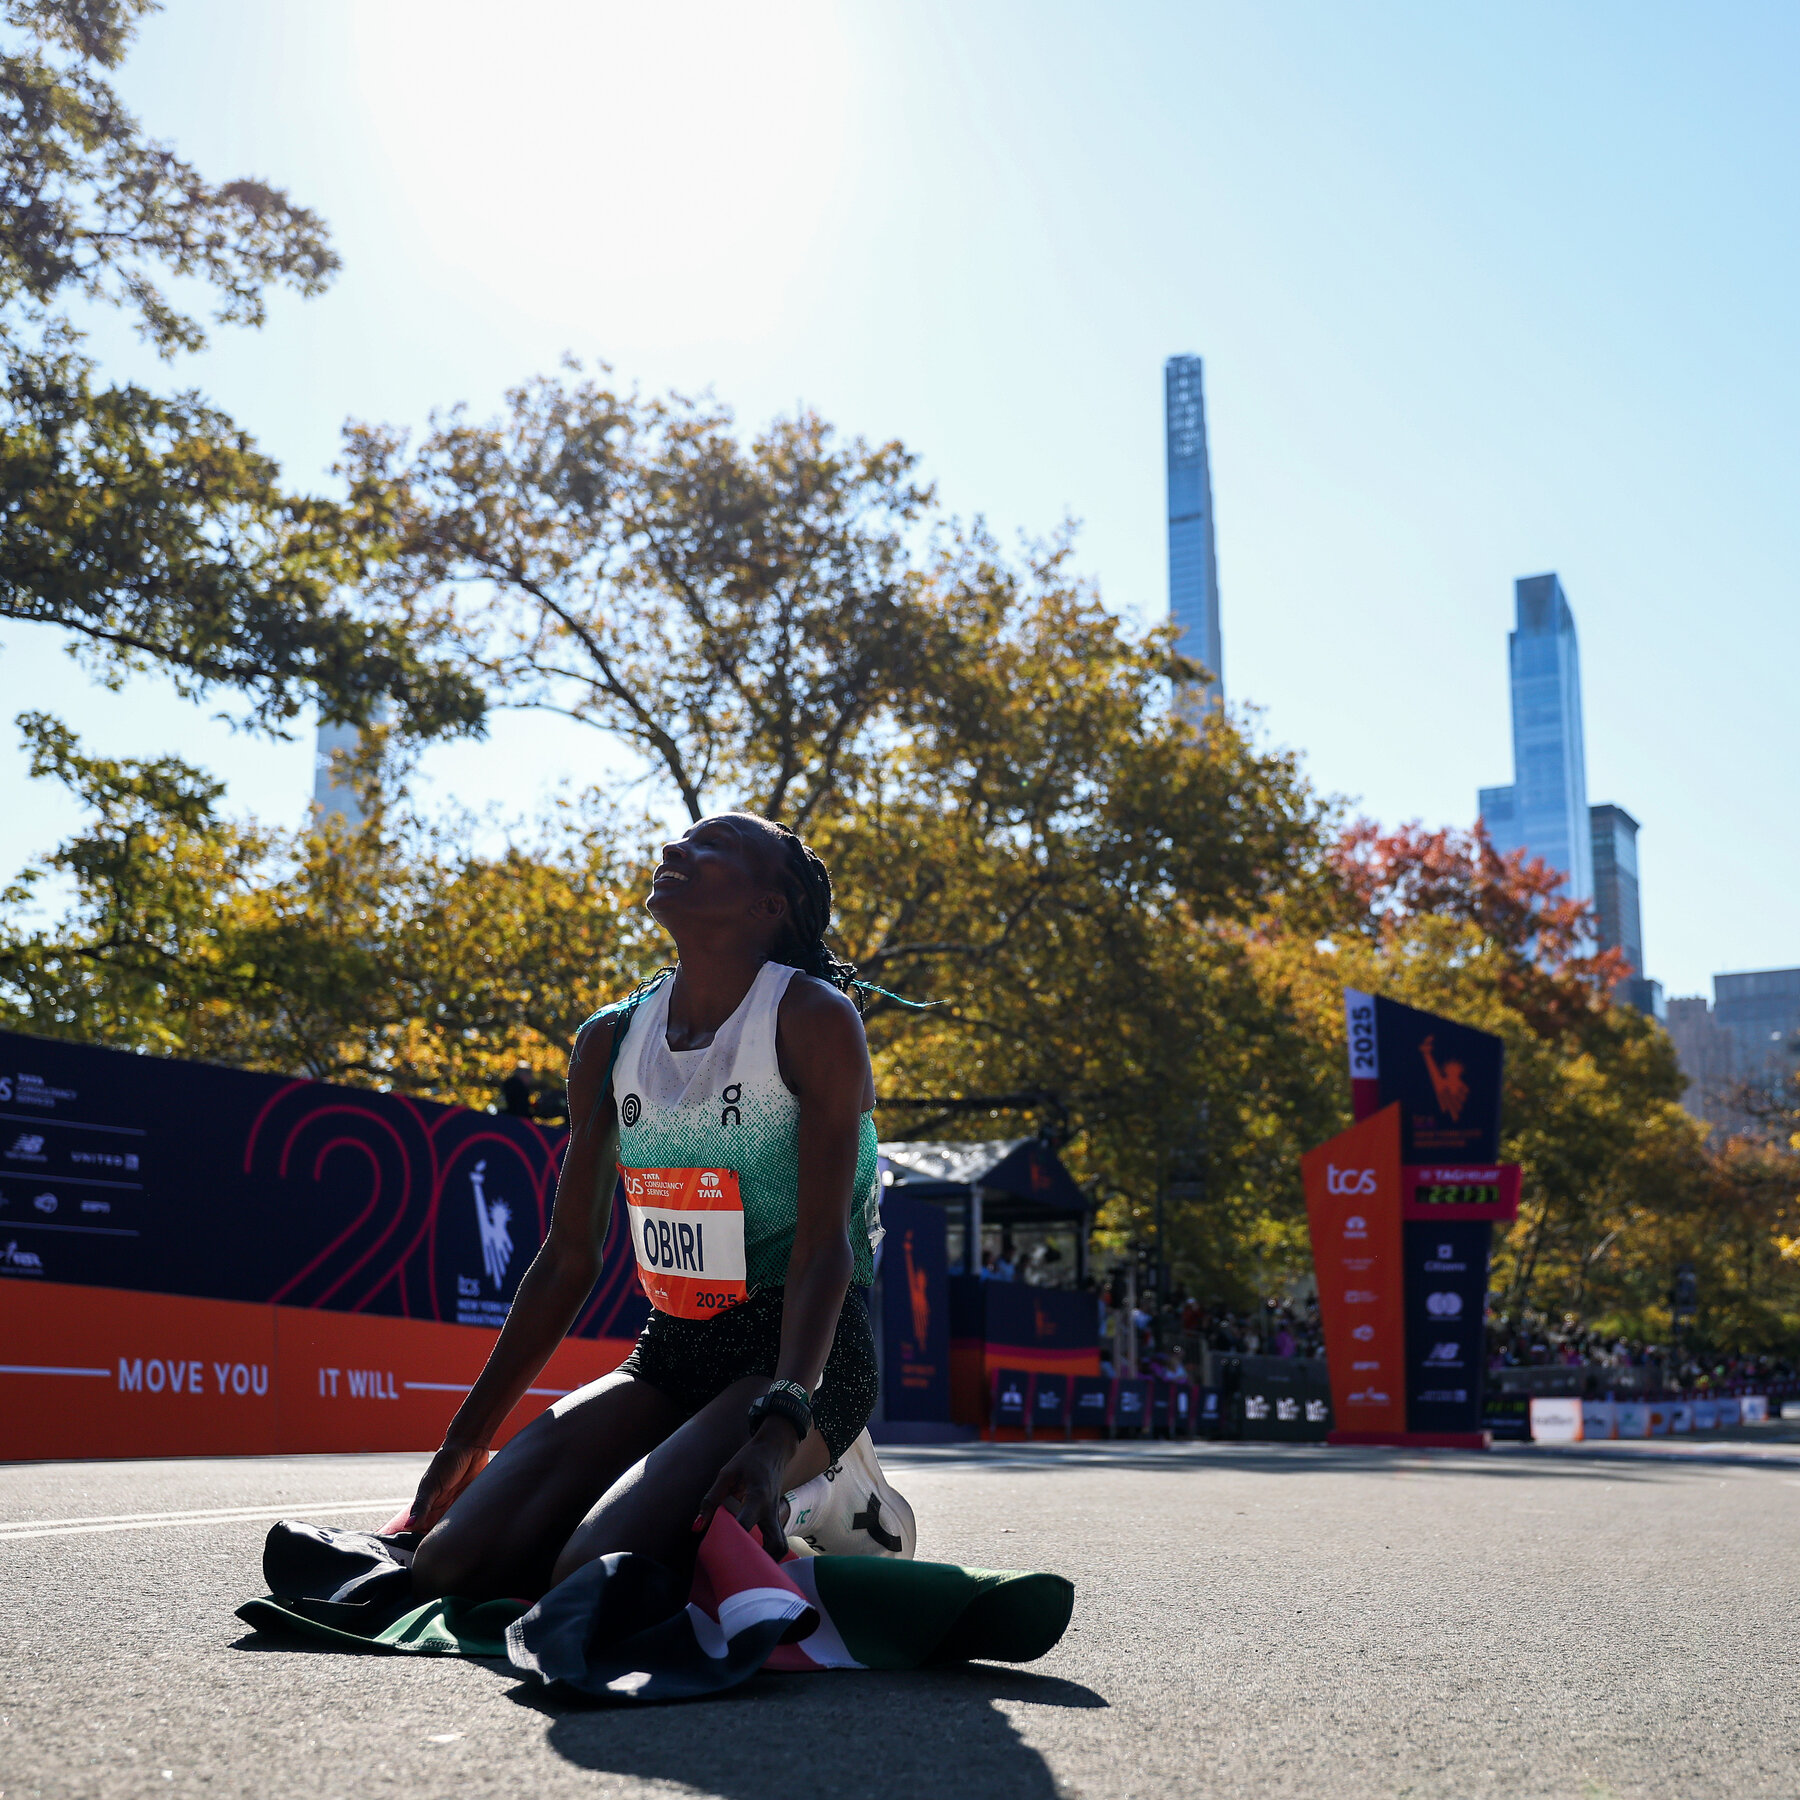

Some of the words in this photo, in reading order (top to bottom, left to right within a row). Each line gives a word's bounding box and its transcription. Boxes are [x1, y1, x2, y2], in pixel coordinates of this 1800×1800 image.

[1352, 1006, 1375, 1069] 2025
[644, 1181, 684, 1190] CONSULTANCY
[647, 1188, 669, 1197] SERVICES
[697, 1189, 723, 1198] TATA
[1327, 1164, 1377, 1195] tcs
[643, 1218, 704, 1272] OBIRI
[696, 1291, 739, 1309] 2025
[119, 1357, 203, 1394] MOVE
[214, 1363, 268, 1396] YOU
[319, 1368, 340, 1398] IT
[347, 1369, 399, 1399] WILL
